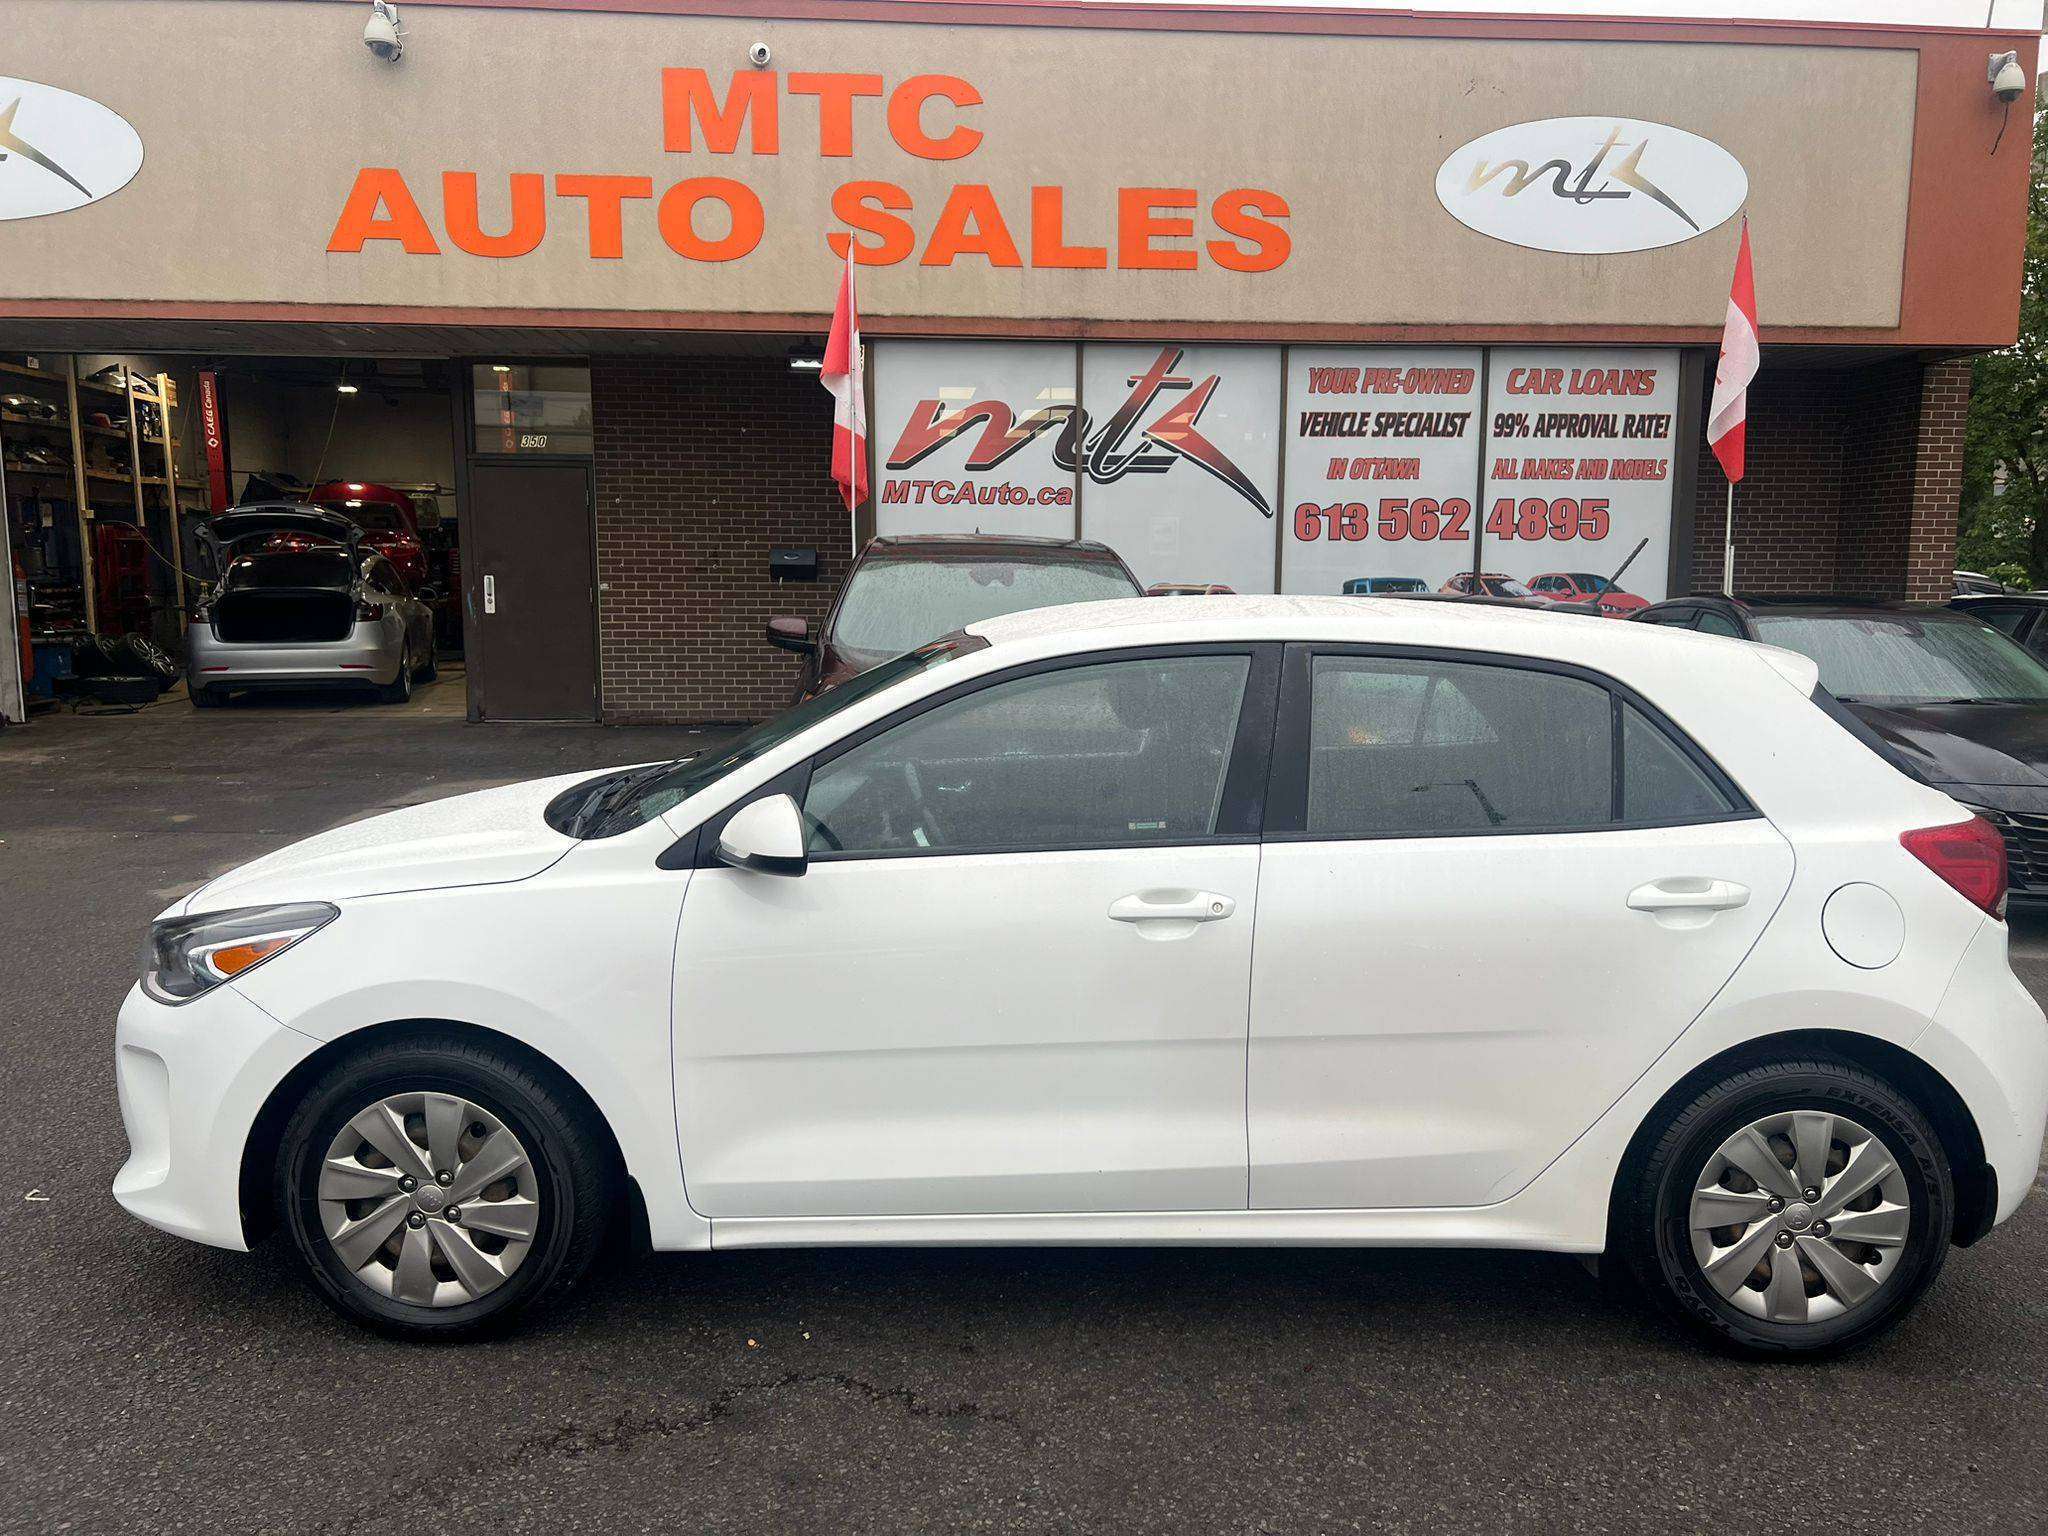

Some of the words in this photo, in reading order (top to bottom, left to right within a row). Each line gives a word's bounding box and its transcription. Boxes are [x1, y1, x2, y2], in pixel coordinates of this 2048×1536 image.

[662, 67, 984, 161] MTC
[326, 168, 765, 263] AUTO
[826, 180, 1293, 273] SALES
[203, 380, 213, 409] Canada
[1308, 366, 1360, 395] YOUR
[1360, 367, 1476, 396] PRE-OWNED
[1505, 367, 1565, 396] CAR
[1569, 368, 1657, 397] LOANS
[1299, 411, 1371, 439] VEHICLE
[1371, 411, 1472, 439] SPECIALIST
[1493, 412, 1530, 439] 99%
[1532, 413, 1619, 439] APPROVAL
[1621, 413, 1672, 440] RATE!
[520, 434, 548, 449] 350
[1326, 457, 1349, 480] IN
[1350, 456, 1422, 481] OTTAWA
[1491, 457, 1519, 480] ALL
[1520, 457, 1575, 481] MAKES
[1576, 457, 1609, 481] AND
[1610, 457, 1668, 481] MODELS
[881, 479, 1074, 506] MTCAuto.ca
[1293, 502, 1369, 542] 613
[1377, 497, 1472, 542] 562
[1485, 497, 1611, 542] 4895
